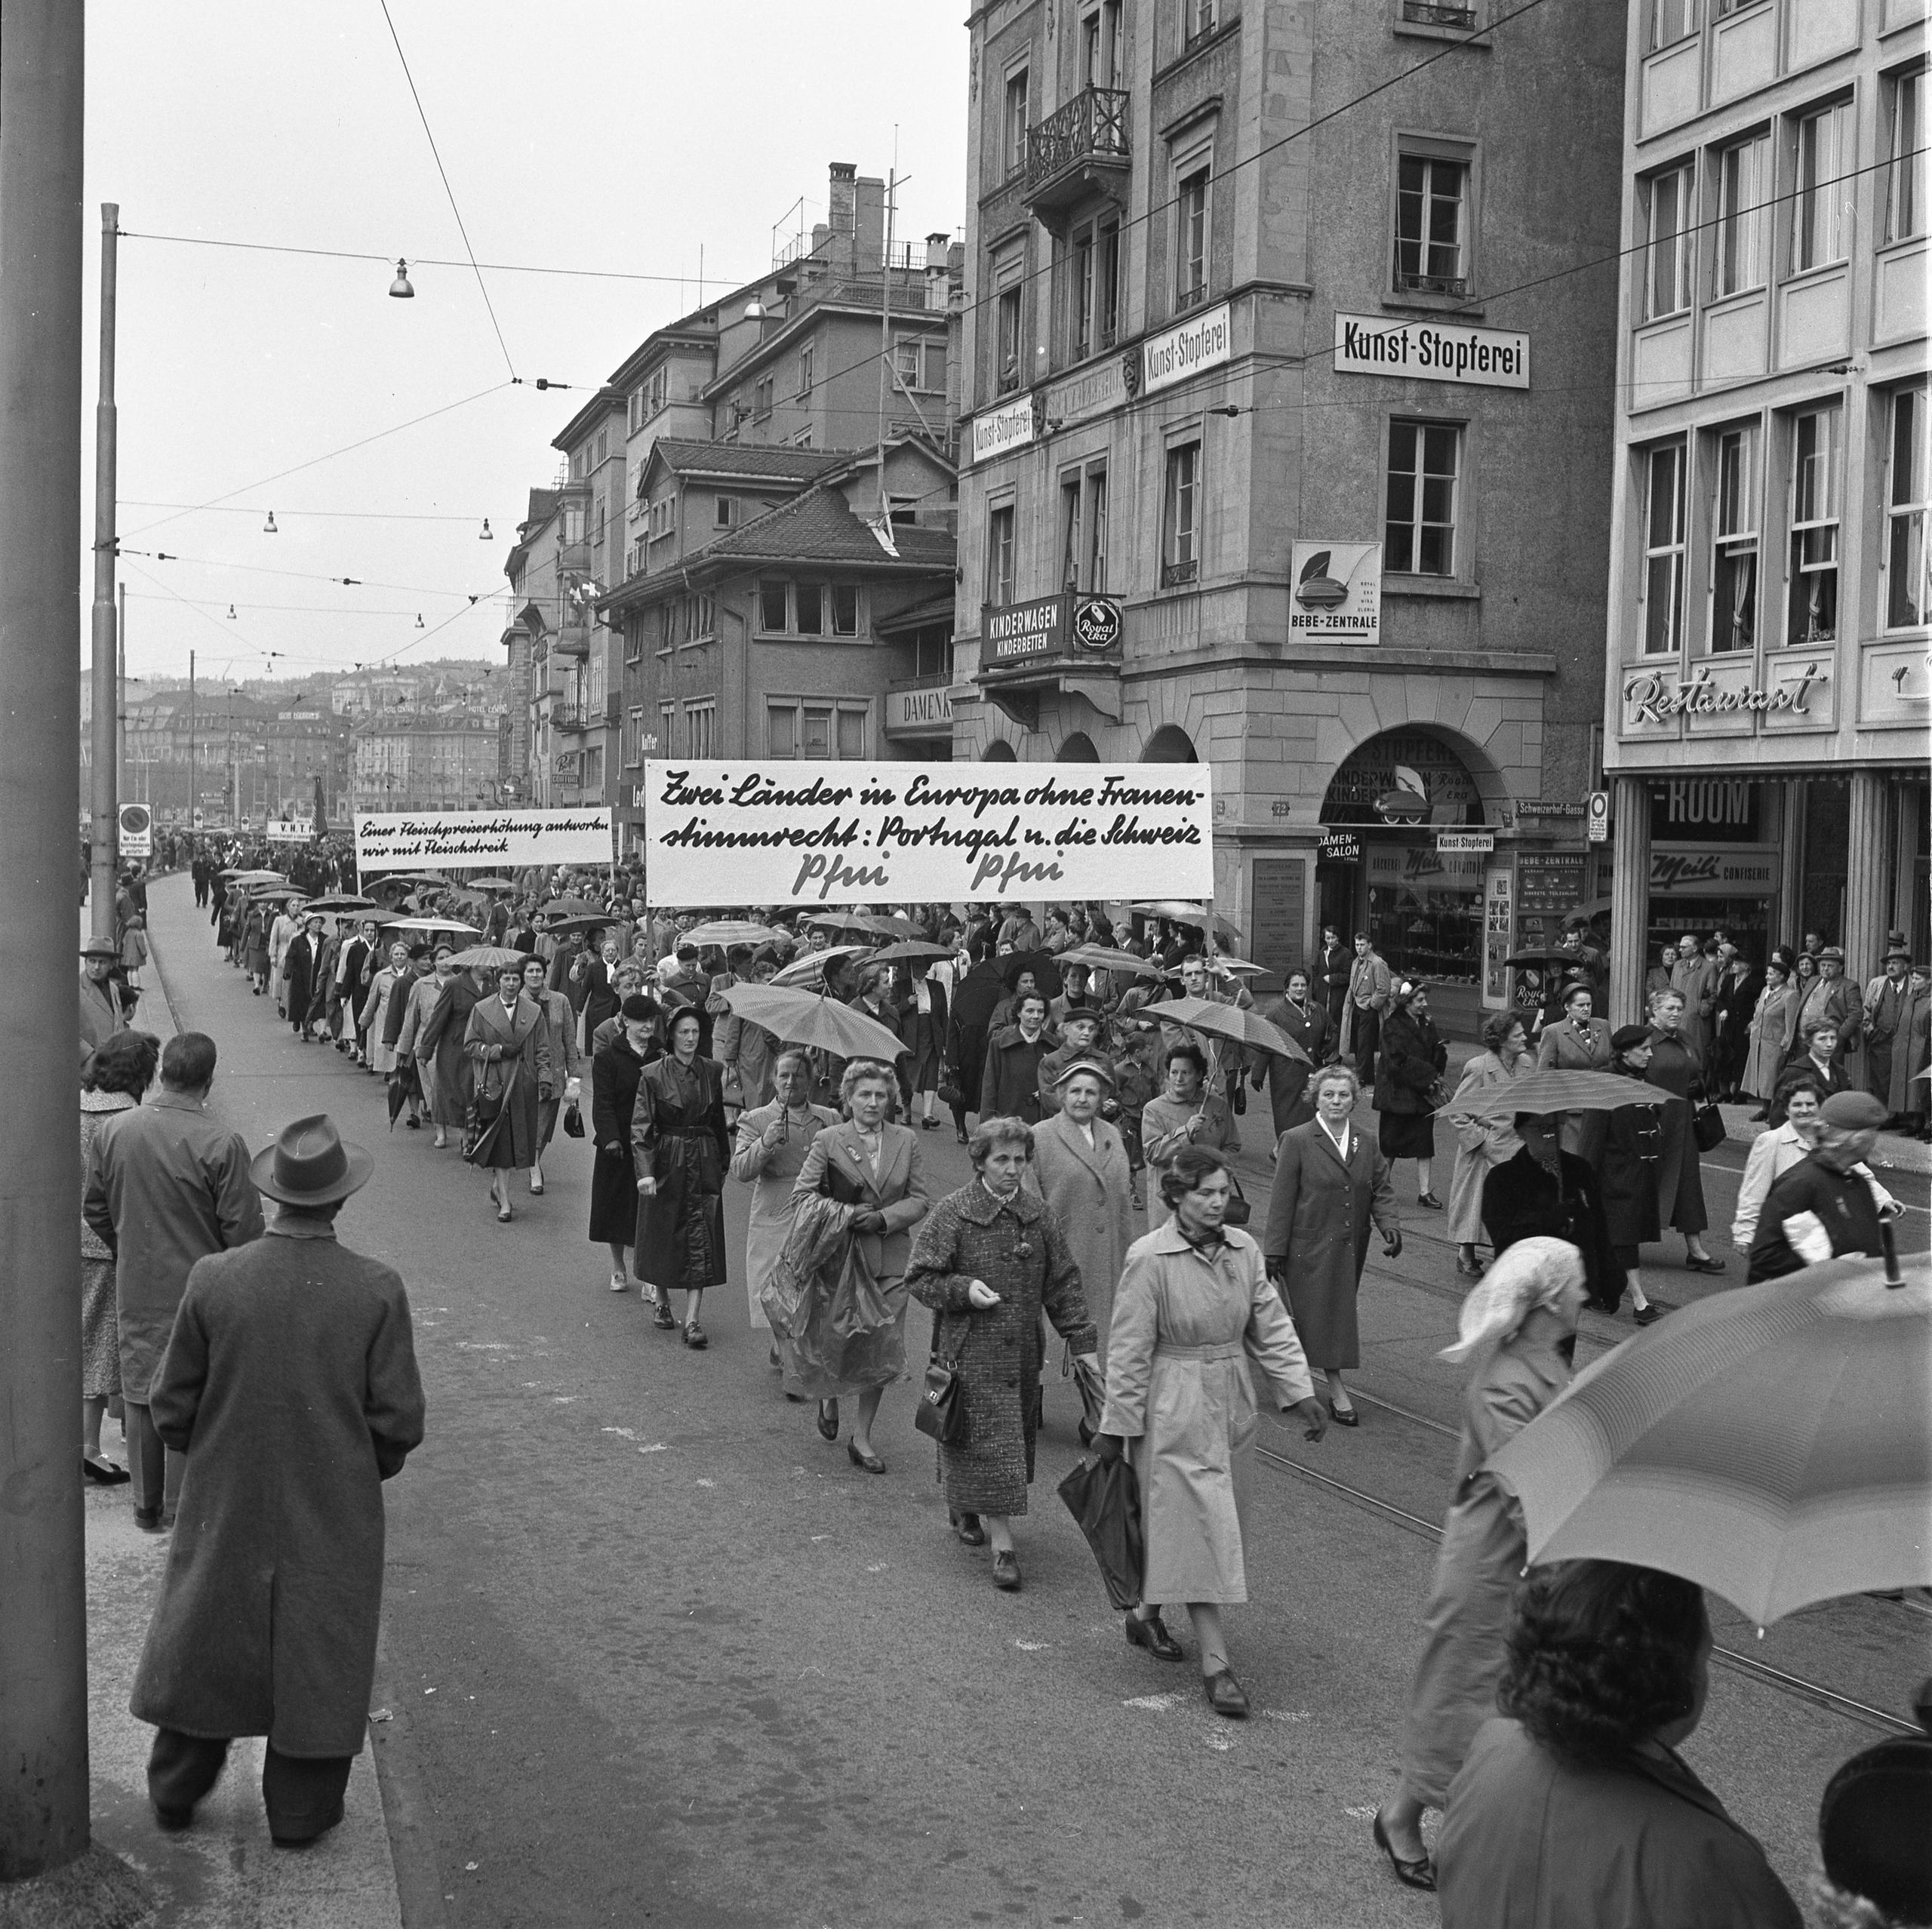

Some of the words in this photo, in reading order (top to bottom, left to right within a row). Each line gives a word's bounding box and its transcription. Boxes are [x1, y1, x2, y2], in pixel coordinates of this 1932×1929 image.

[1148, 313, 1226, 381] Kunst-Stopferei
[1345, 321, 1521, 377] Kunst-Stopferei
[975, 402, 1030, 452] Kunst-Stopferei
[989, 604, 1057, 640] KINDERWAGEN
[1080, 619, 1114, 635] Royal
[1291, 615, 1377, 629] BEBE-ZENTRALE
[997, 632, 1048, 657] KINDERBETTEN
[904, 691, 954, 721] DAMENK
[1624, 663, 1828, 725] Restaurant
[660, 771, 729, 806] Zwei
[728, 773, 854, 808] Länder
[860, 777, 897, 806] in
[903, 774, 1020, 819] Europa
[1023, 777, 1094, 806] ohne
[1097, 775, 1205, 807] Frauen-
[1275, 803, 1286, 814] 72
[1520, 802, 1585, 816] Schweizerhof-Gasse
[359, 820, 396, 838] Einer
[399, 817, 544, 841] Fleischpreiserhöhung
[545, 816, 609, 832] antworten
[875, 815, 1020, 864] Portugal
[1023, 829, 1051, 847] u.
[1054, 816, 1097, 846] die
[1100, 814, 1201, 845] Schweiz
[362, 843, 390, 857] wir
[392, 838, 423, 856] mit
[424, 837, 509, 855] Fleischstreik
[1326, 845, 1359, 857] SALON
[1438, 836, 1492, 850] Kunst-Stopferei
[791, 850, 891, 900] Pfui
[970, 849, 1064, 894] Pfui
[1650, 854, 1721, 889] Meili
[1724, 867, 1770, 881] CONFISERIE
